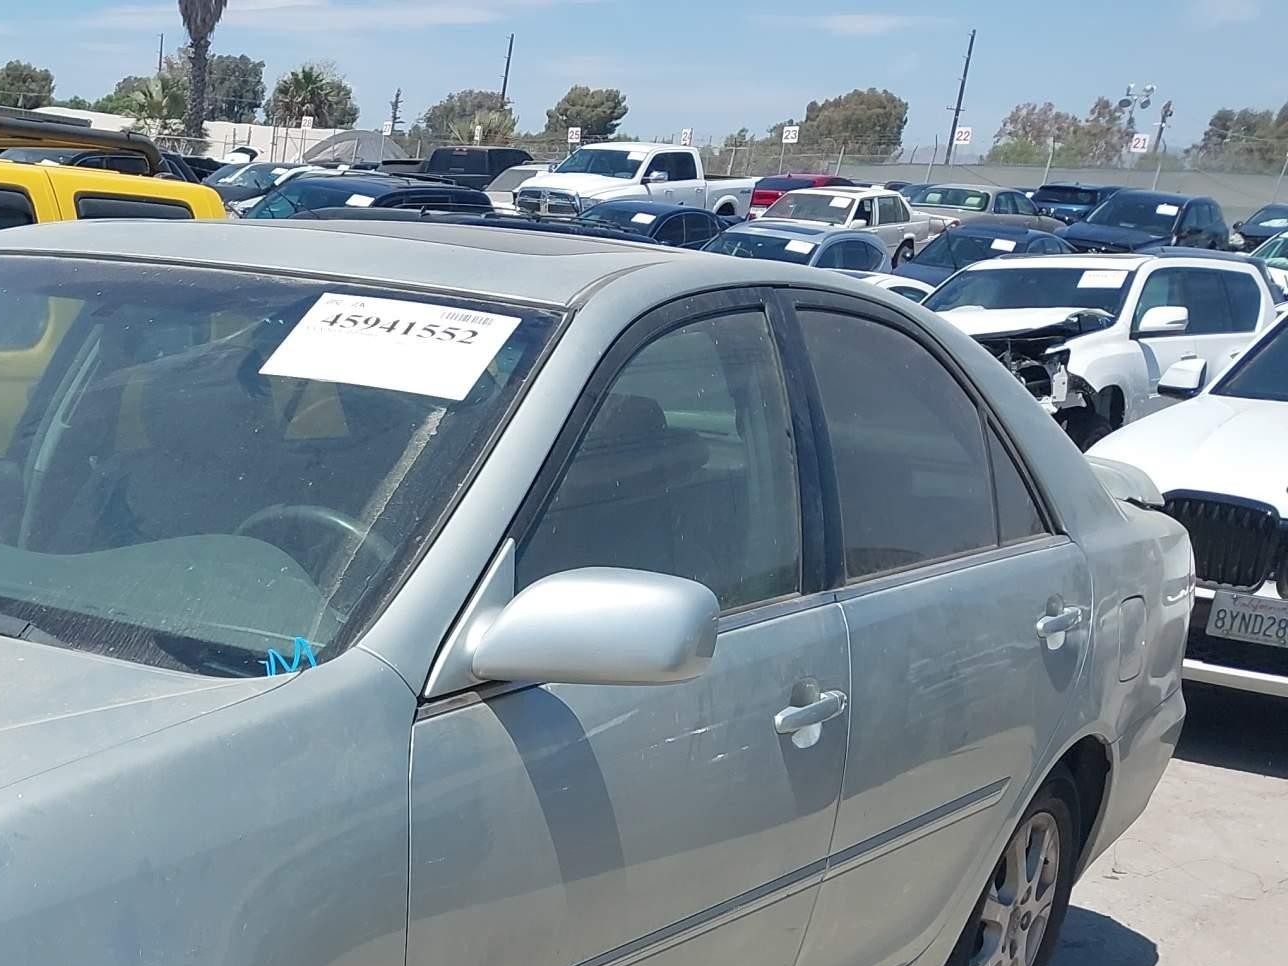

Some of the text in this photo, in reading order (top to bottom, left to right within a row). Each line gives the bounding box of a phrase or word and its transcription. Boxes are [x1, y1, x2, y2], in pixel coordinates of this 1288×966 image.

[569, 130, 580, 140] 25
[783, 129, 798, 140] 23
[955, 130, 970, 142] 22
[1133, 138, 1147, 149] 21
[320, 312, 479, 345] 45941552
[1215, 608, 1288, 639] 8YND28
